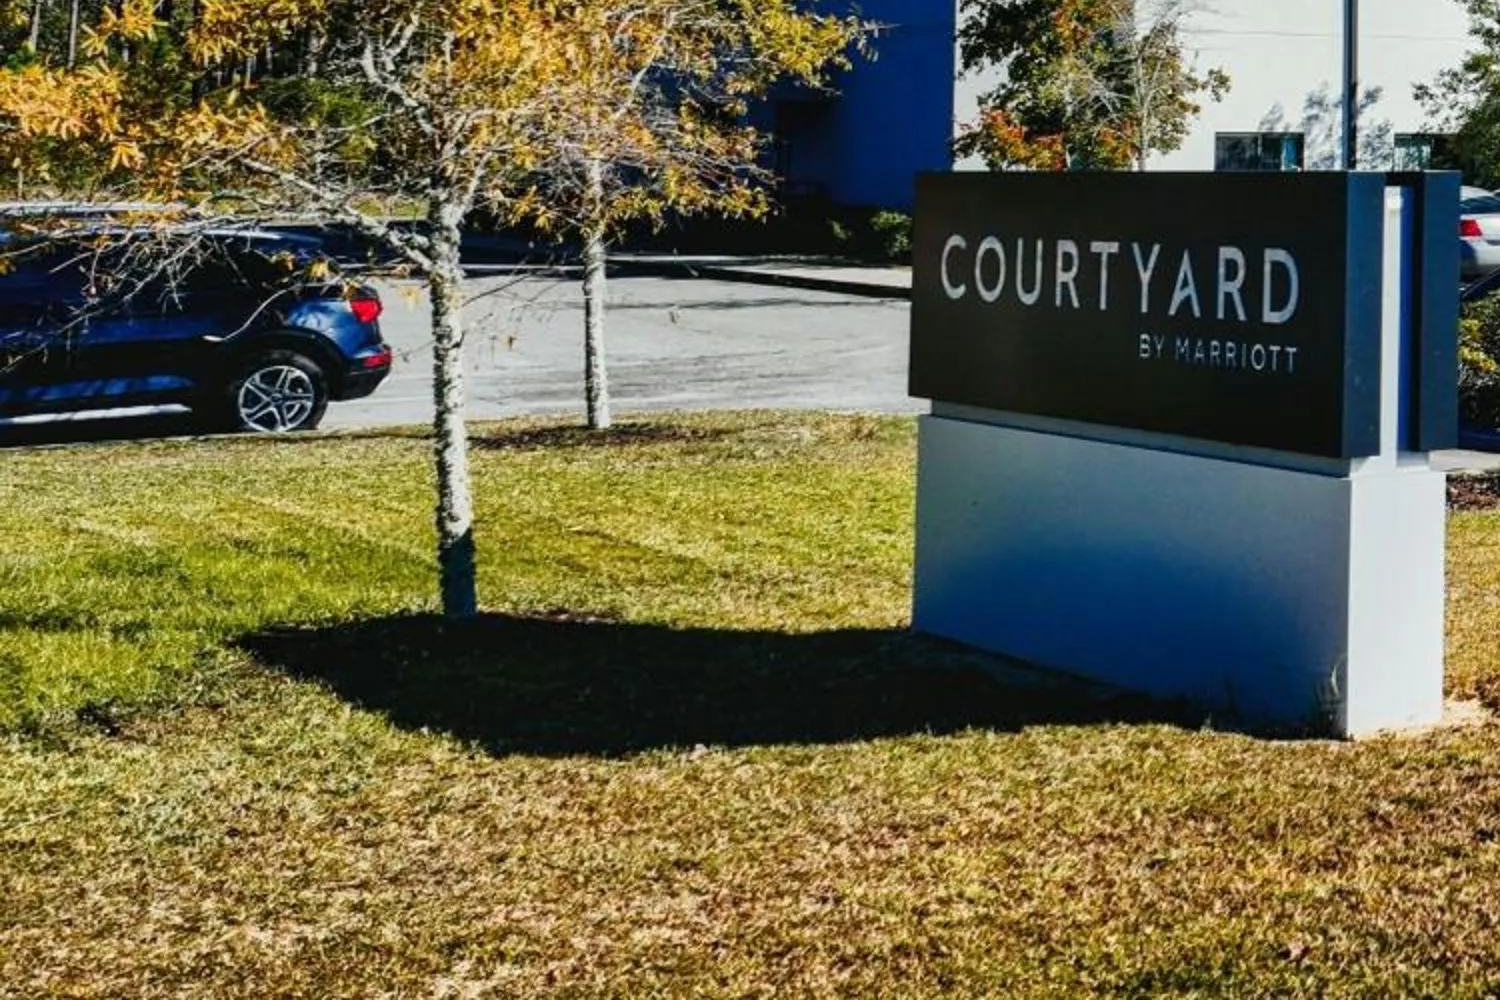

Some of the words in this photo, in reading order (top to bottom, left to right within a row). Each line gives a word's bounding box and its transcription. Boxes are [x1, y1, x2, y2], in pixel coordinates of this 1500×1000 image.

[941, 234, 1300, 324] COURTYARD
[1139, 333, 1165, 358] BY
[1175, 336, 1297, 372] MARRIOTT
